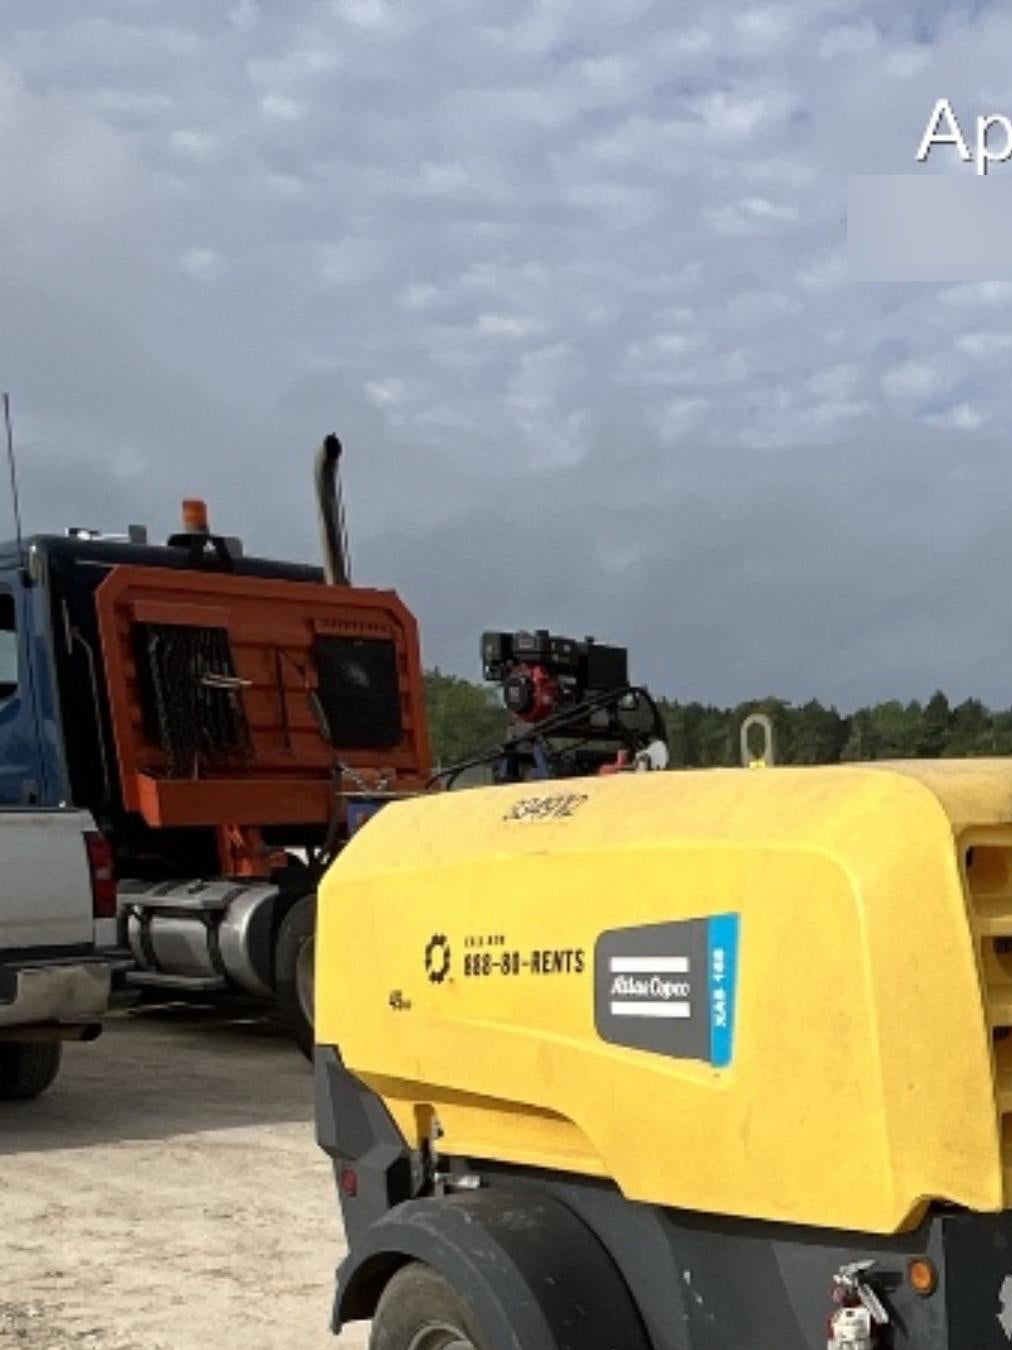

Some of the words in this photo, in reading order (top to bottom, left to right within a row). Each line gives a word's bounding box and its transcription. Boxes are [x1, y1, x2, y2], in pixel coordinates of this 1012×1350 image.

[463, 949, 586, 977] 888-80-RENTS
[611, 975, 648, 995] Atlas
[650, 975, 691, 999] Copco
